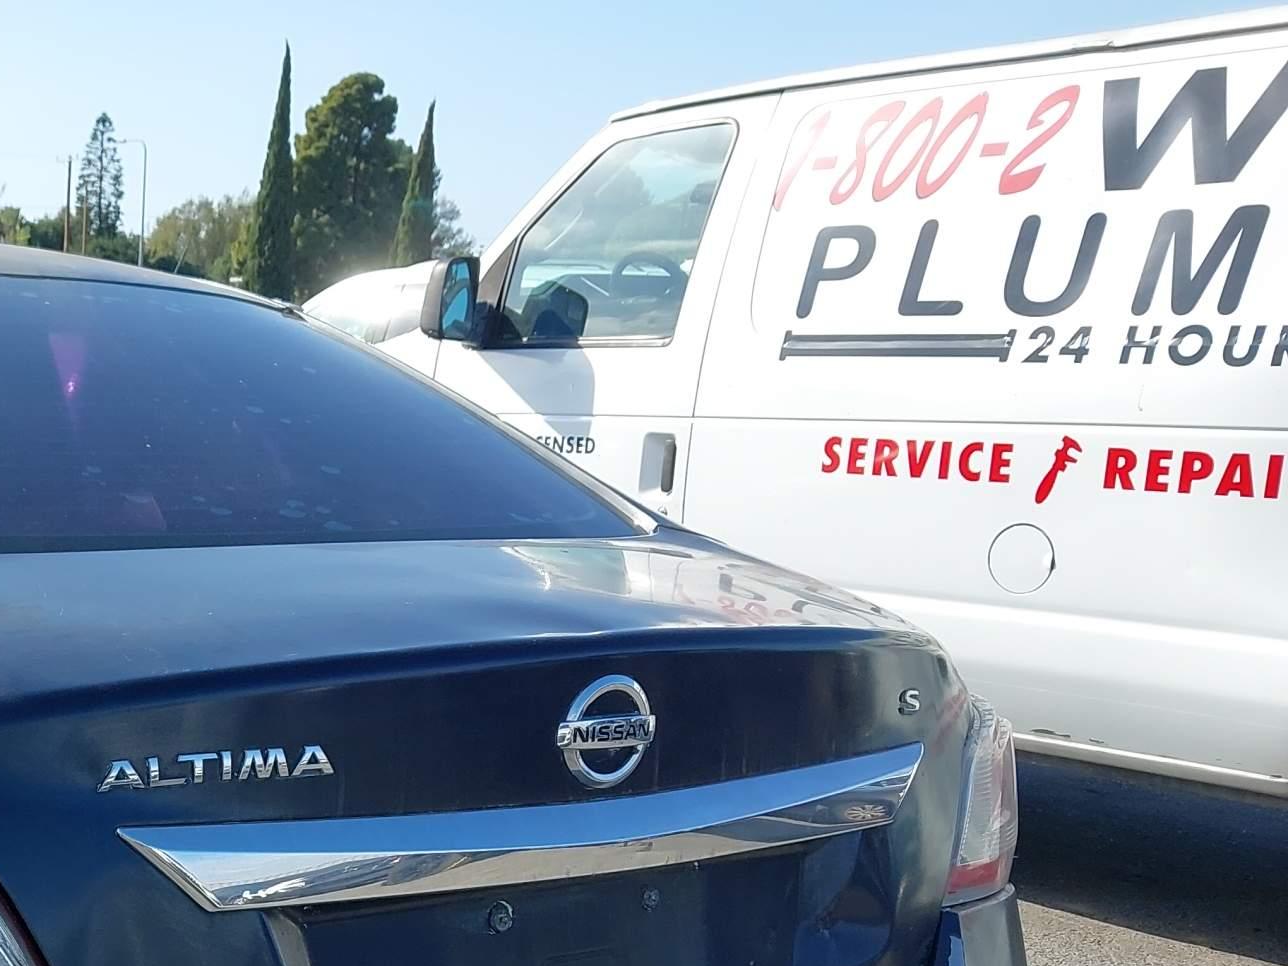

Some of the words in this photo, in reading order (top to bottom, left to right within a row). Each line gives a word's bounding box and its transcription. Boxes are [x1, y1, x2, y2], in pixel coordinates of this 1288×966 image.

[796, 204, 1272, 319] PLUM
[1021, 325, 1093, 364] 24
[821, 436, 1014, 483] SERVICE
[1102, 447, 1285, 499] REPAI
[898, 688, 921, 716] S
[572, 722, 650, 744] NISSAN
[96, 745, 336, 793] ALTIMA
